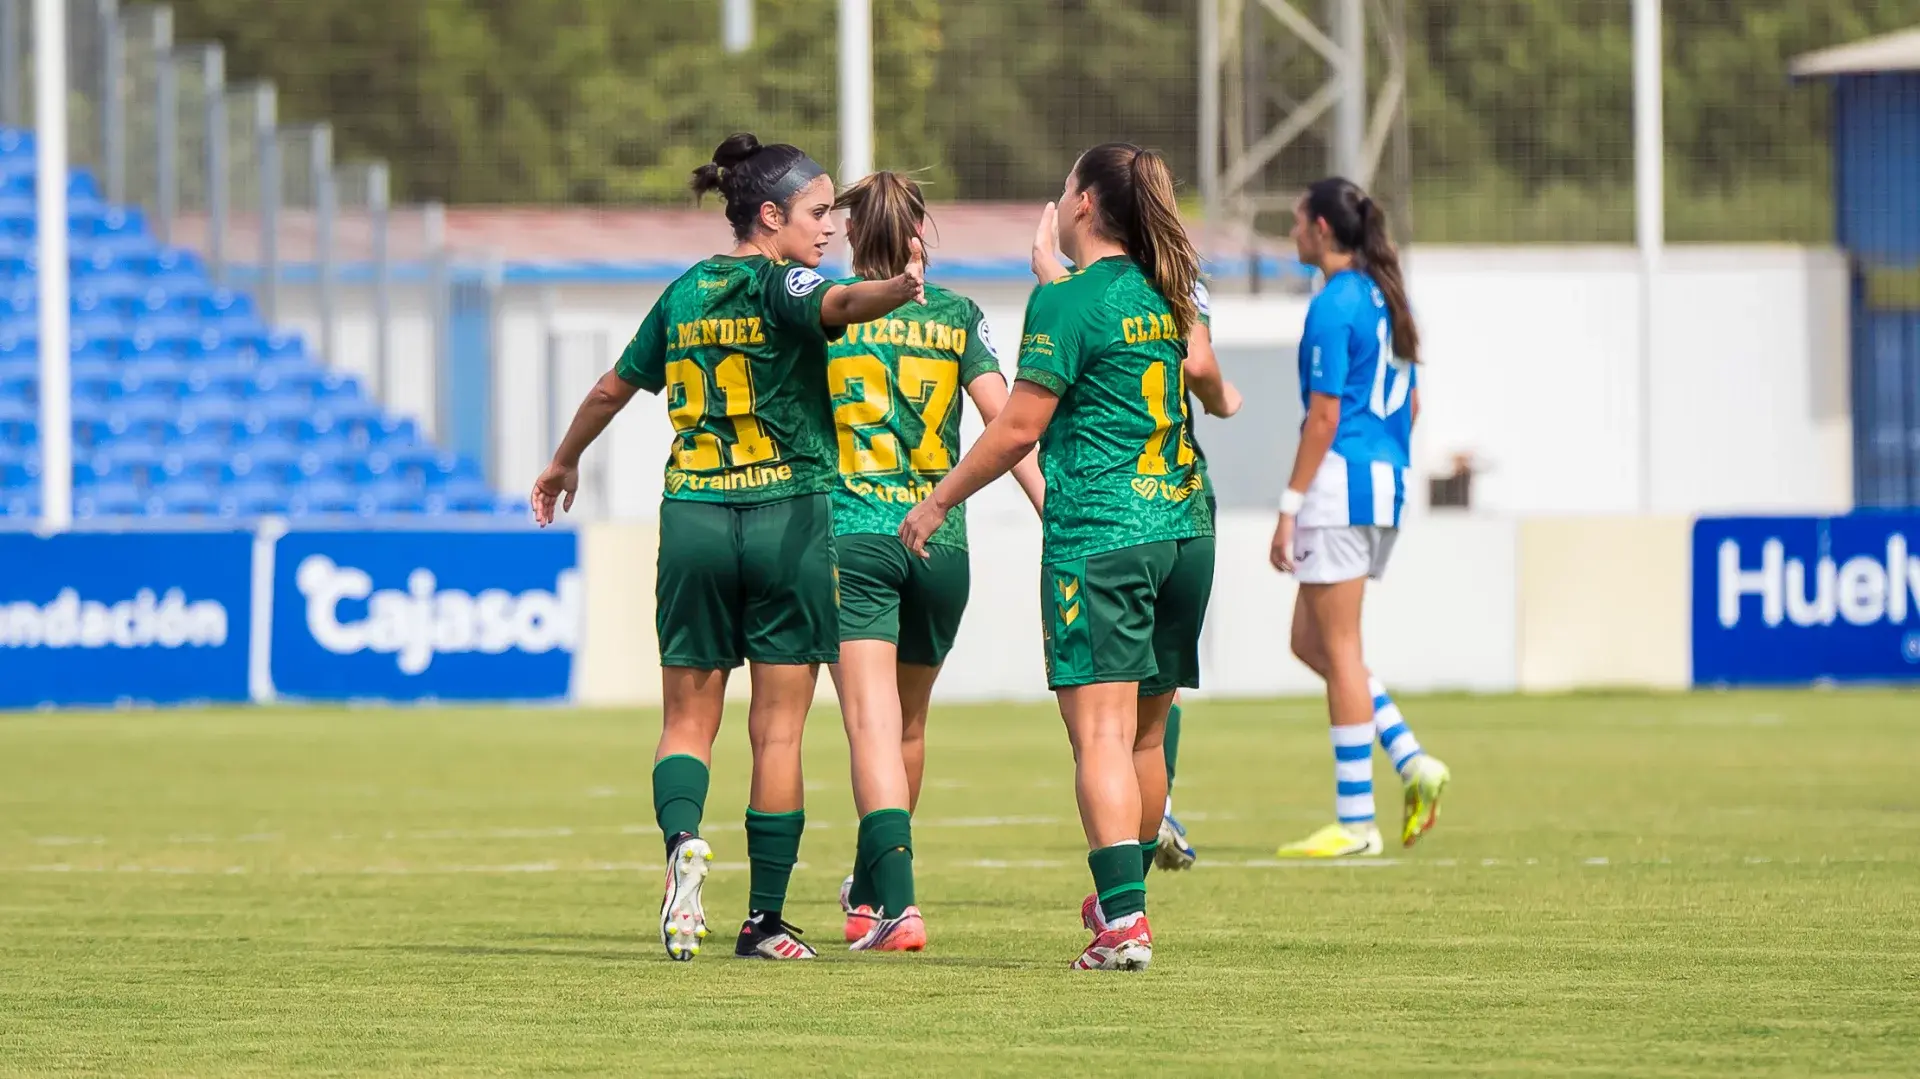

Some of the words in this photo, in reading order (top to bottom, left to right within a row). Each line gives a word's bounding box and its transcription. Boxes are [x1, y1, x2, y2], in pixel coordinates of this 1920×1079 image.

[665, 353, 781, 470] 21
[828, 354, 957, 476] 27
[686, 464, 793, 490] trainline
[0, 586, 228, 648] ndación
[295, 553, 578, 676] Cajasol
